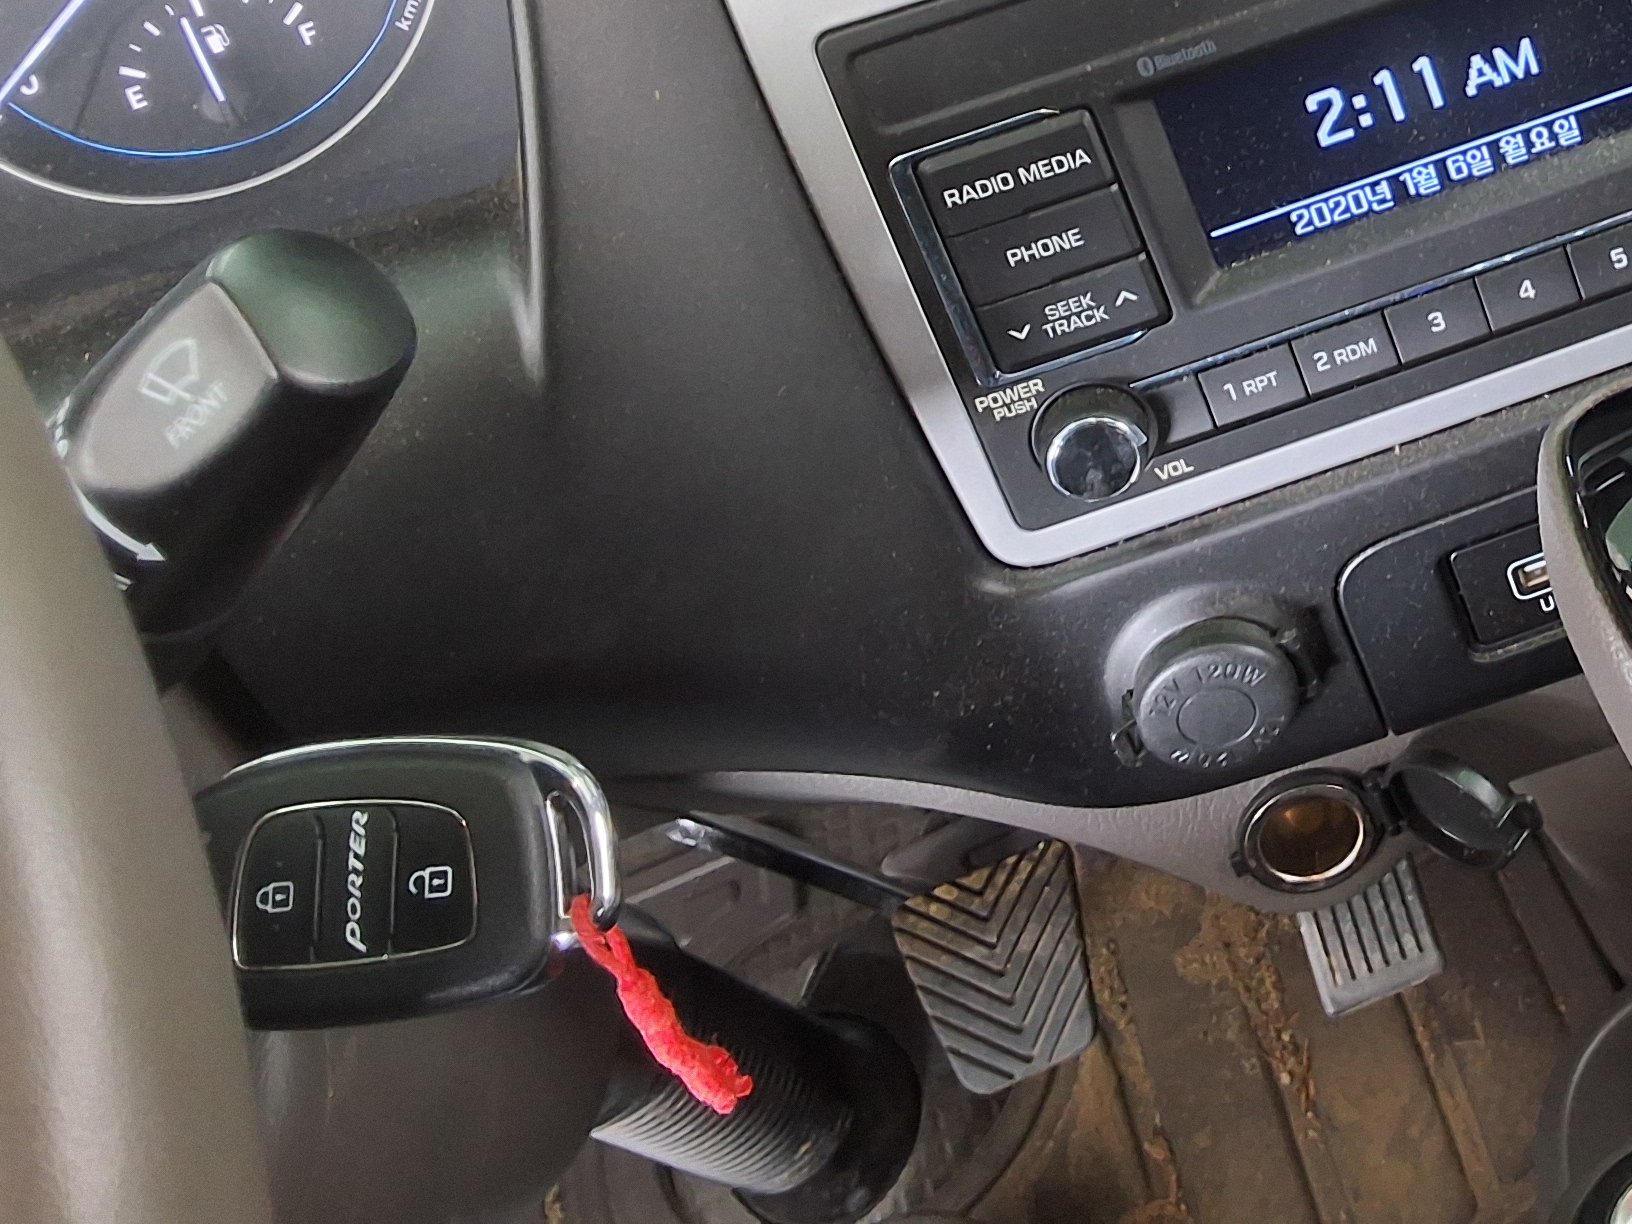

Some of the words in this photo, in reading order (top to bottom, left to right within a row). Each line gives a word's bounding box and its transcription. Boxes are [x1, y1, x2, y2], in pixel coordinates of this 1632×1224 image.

[298, 21, 316, 46] F
[124, 85, 148, 111] E
[1304, 54, 1446, 148] 2:11
[1464, 36, 1541, 98] AM
[942, 171, 1016, 209] RADIO
[1017, 147, 1092, 186] MEDIA
[1289, 179, 1395, 236] 2020년
[1398, 163, 1442, 197] 1월
[1445, 145, 1495, 182] 6일
[1499, 115, 1583, 166] 월요일
[1005, 227, 1086, 268] PHONE
[1609, 246, 1629, 270] 5
[1518, 278, 1536, 301] 4
[1043, 291, 1098, 322] SEEK
[1427, 310, 1446, 333] 3
[1041, 307, 1110, 340] TRACK
[1313, 351, 1331, 372] 2
[1333, 337, 1378, 366] RDM
[974, 377, 1045, 413] POWER
[1223, 383, 1237, 401] 1
[1242, 370, 1278, 397] RPT
[166, 380, 228, 450] FRONT
[992, 396, 1038, 422] PUSH
[1153, 457, 1195, 482] VOL
[345, 809, 370, 954] PORTER
